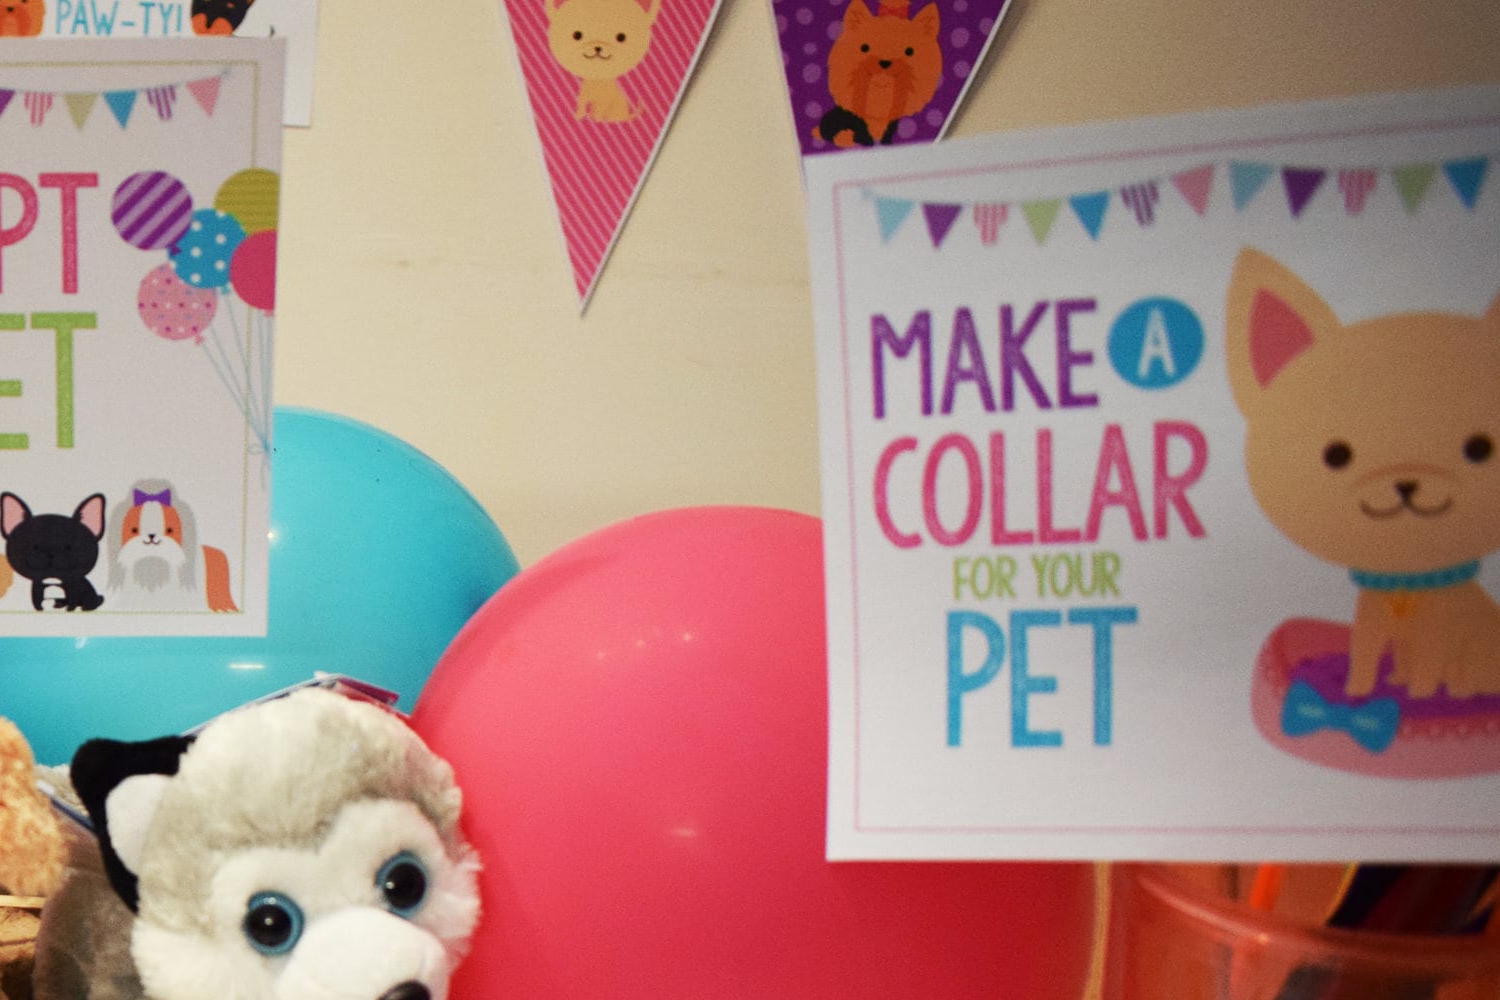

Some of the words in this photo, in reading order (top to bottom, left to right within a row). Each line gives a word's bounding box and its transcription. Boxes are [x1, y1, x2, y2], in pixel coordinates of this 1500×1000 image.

[54, 0, 183, 36] PAW-TY!
[870, 300, 1100, 419] MAKE
[1138, 308, 1176, 380] A
[873, 421, 1210, 549] COLLAR
[952, 556, 1017, 601] FOR
[1032, 552, 1122, 598] YOUR
[946, 606, 1139, 749] PET
